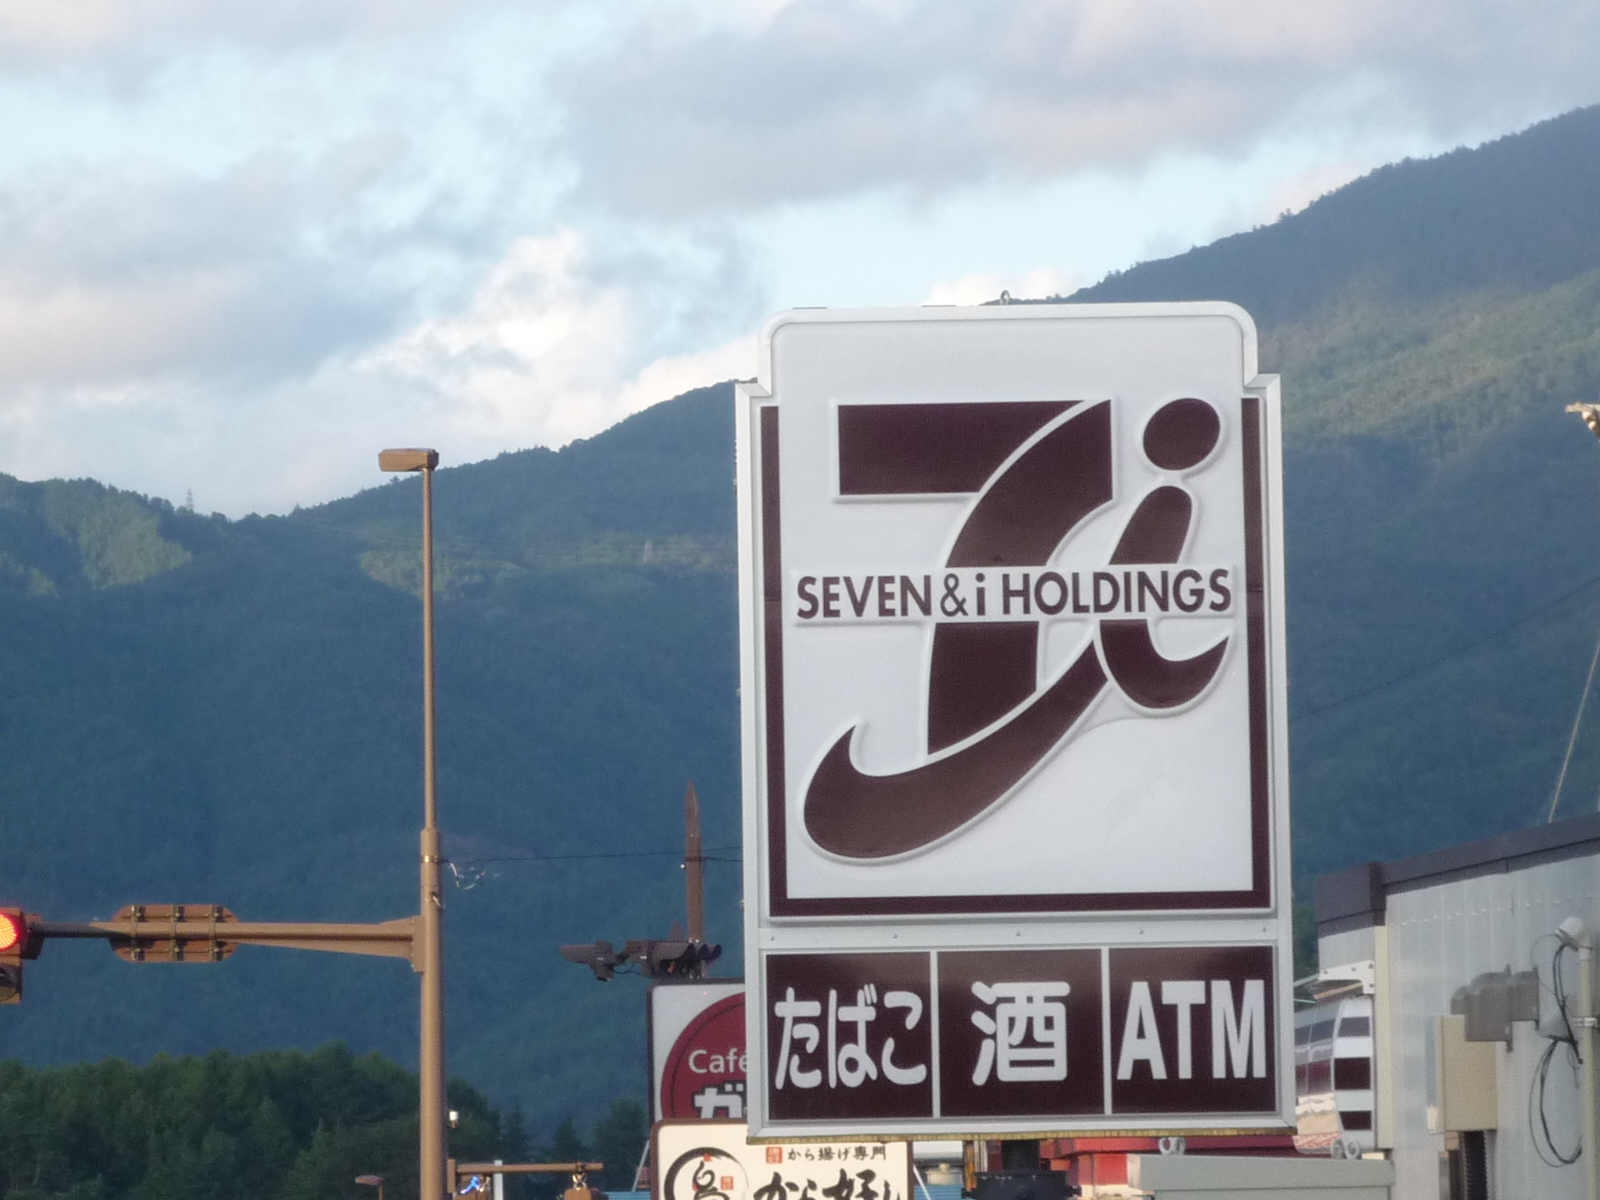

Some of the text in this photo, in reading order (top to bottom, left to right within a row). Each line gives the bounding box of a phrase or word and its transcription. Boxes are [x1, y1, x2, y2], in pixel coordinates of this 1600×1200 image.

[1002, 568, 1232, 616] HOLDINGS
[774, 983, 927, 1090] たばこ
[970, 980, 1071, 1086] 酒
[1116, 979, 1267, 1080] ATM
